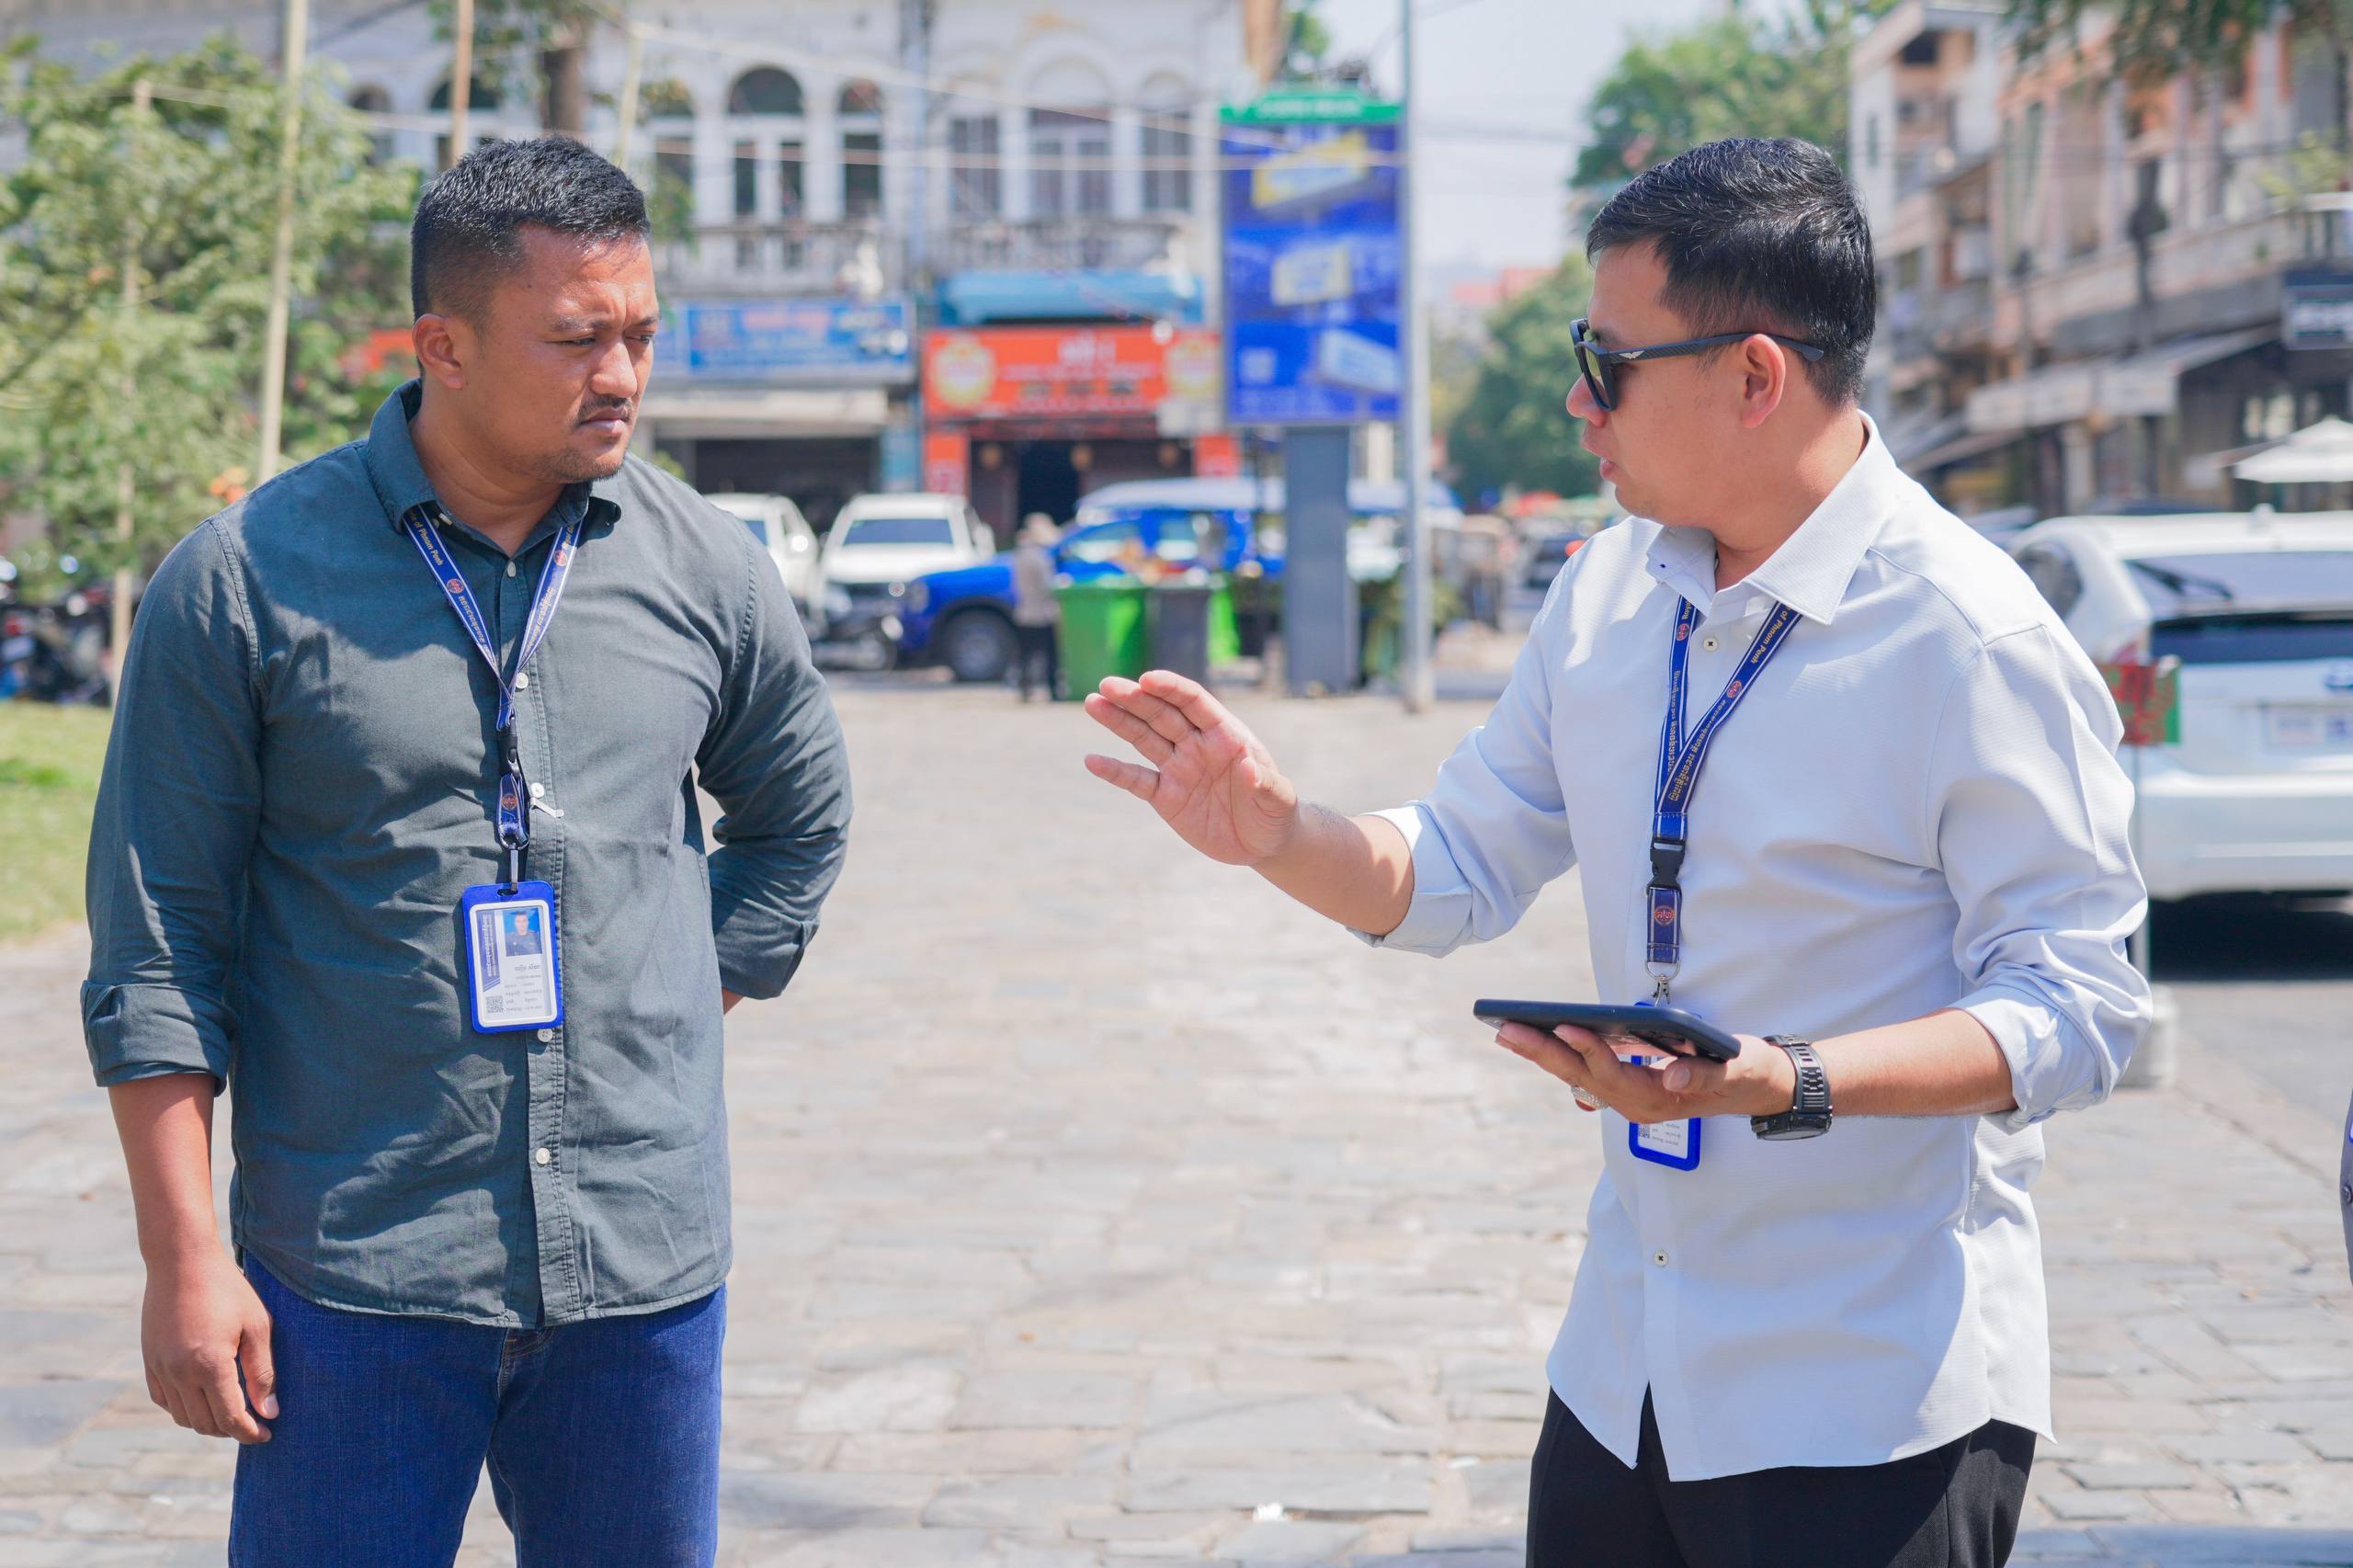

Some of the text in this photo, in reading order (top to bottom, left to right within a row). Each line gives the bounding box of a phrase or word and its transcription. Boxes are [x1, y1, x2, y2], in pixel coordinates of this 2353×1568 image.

[419, 528, 434, 551] Phnom
[431, 550, 444, 566] Penh
[1750, 610, 1788, 664] of Phnom Penh
